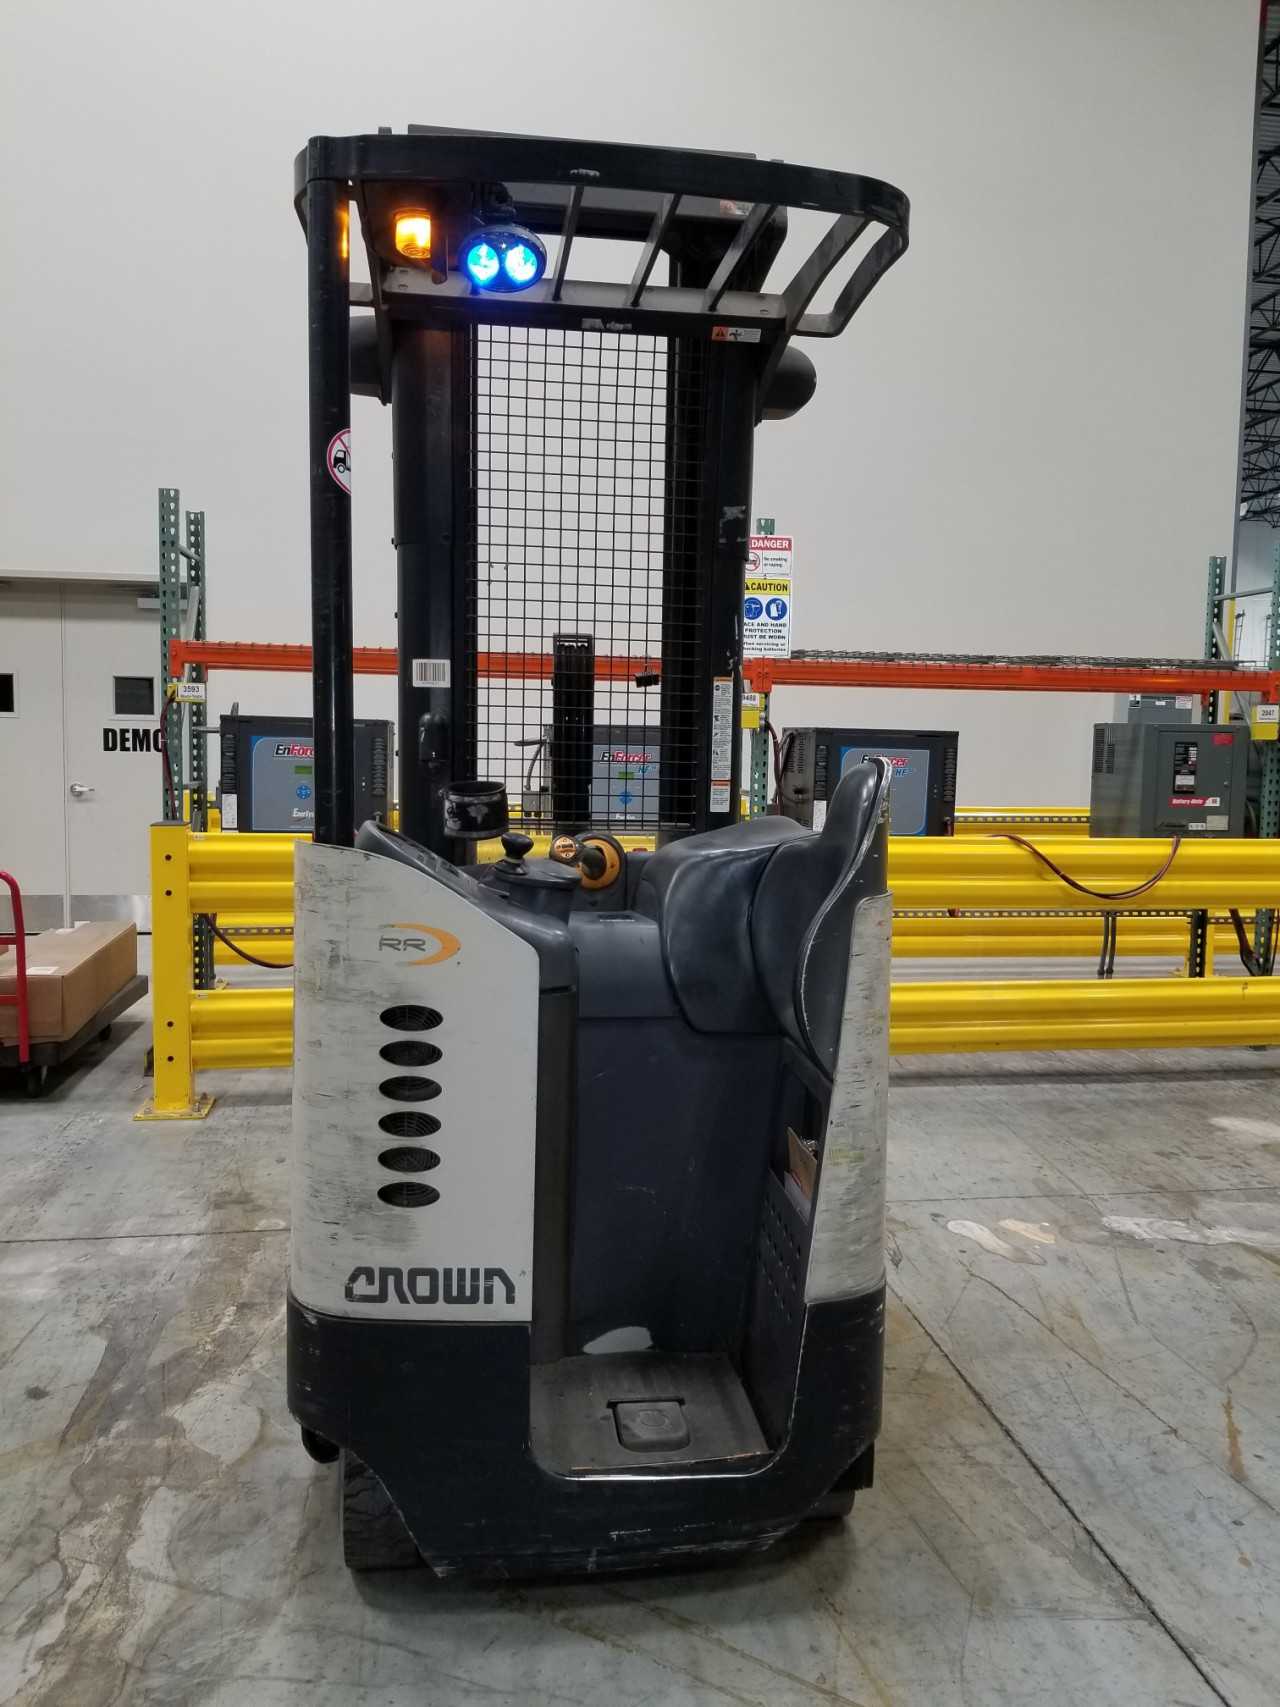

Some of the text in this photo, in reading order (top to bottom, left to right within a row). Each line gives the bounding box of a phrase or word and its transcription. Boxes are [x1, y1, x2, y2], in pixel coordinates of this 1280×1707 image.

[751, 539, 790, 549] DANGER
[750, 582, 788, 592] CAUTION
[183, 685, 200, 693] 3593
[378, 935, 426, 952] RR
[344, 1265, 516, 1305] CROWN
